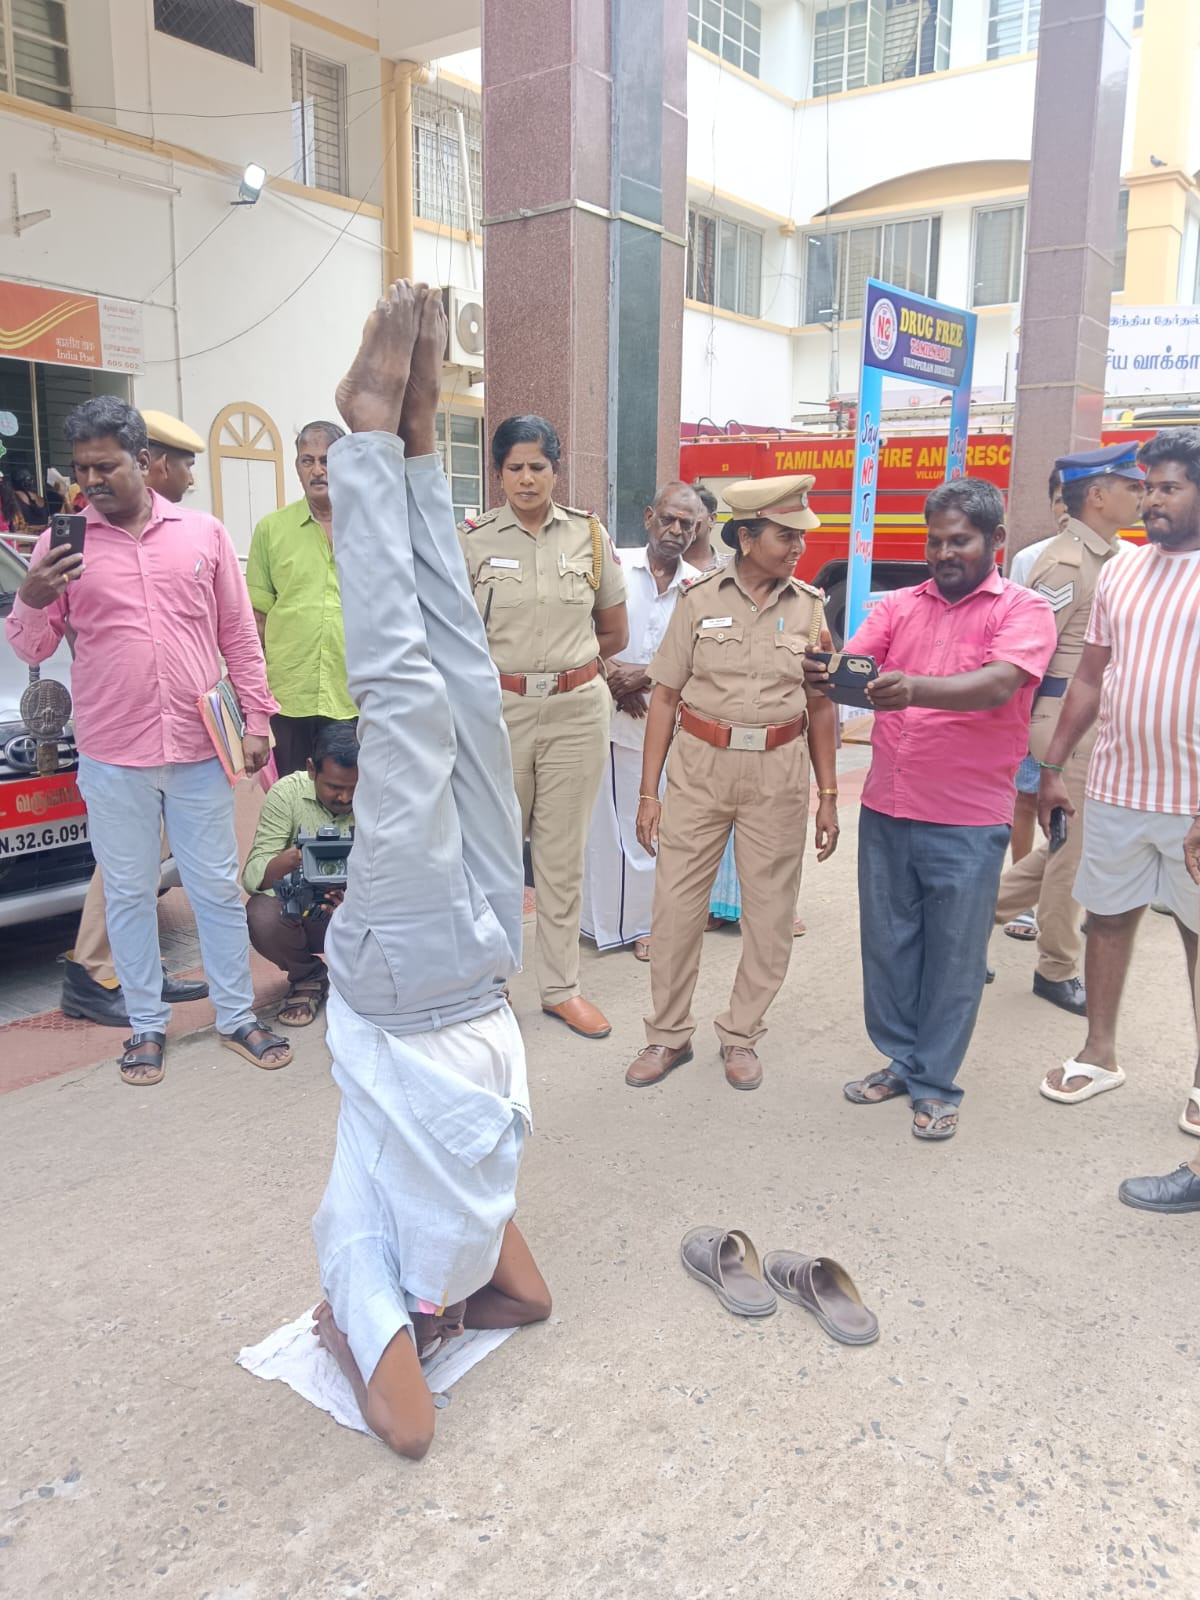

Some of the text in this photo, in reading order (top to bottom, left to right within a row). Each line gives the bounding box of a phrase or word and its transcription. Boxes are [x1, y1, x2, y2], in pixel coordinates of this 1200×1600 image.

[900, 308, 963, 348] DRUG FREE
[56, 348, 78, 361] India
[79, 351, 96, 363] Post
[1133, 345, 1200, 370] வாக்கா
[862, 412, 878, 455] Say
[775, 444, 1012, 471] TAMILNAD FIRE AN RESC
[916, 470, 946, 480] VILLUP
[861, 493, 871, 523] To
[0, 823, 88, 855] N.32.G.091
